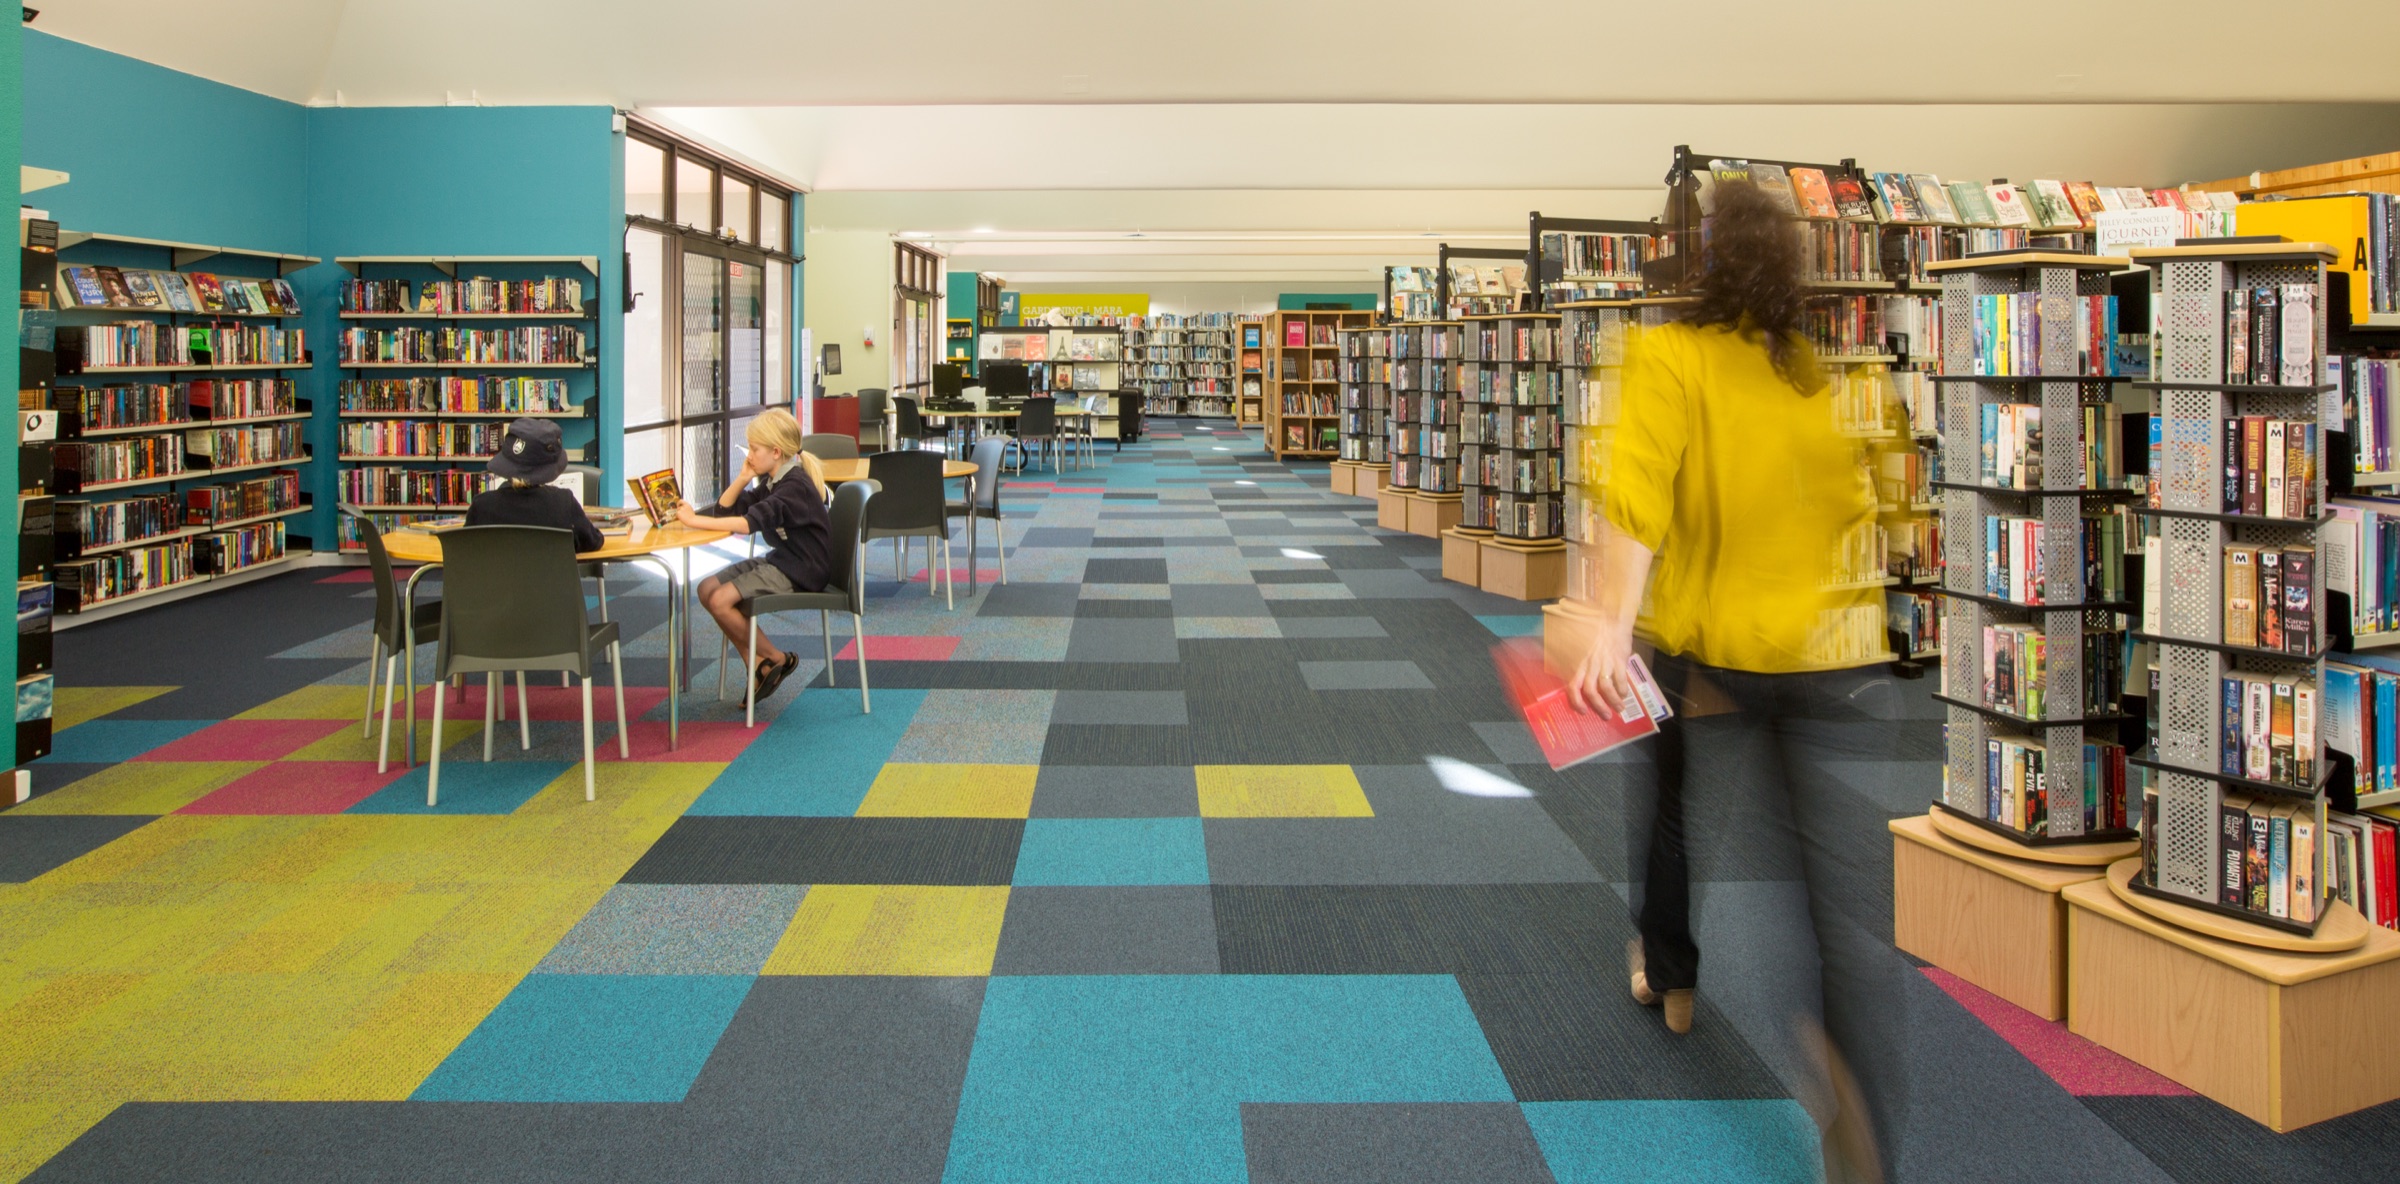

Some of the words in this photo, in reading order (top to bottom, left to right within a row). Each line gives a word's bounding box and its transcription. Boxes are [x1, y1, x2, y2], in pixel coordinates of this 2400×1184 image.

[1837, 201, 1869, 210] WILBUR
[2100, 218, 2121, 227] BILLY
[2122, 215, 2170, 225] CONNOLLY
[2102, 225, 2170, 241] JOURNEY
[2353, 237, 2368, 271] A
[80, 289, 103, 297] FURY
[1022, 306, 1084, 315] GARDNING
[1093, 306, 1123, 315] MARA
[2264, 307, 2272, 346] elizabeth
[2263, 349, 2271, 371] moon
[2248, 421, 2259, 440] BARRY
[2270, 429, 2282, 437] M
[2248, 441, 2259, 470] MAITLAND
[2296, 449, 2304, 476] LINDSAY
[2235, 554, 2247, 563] M
[2285, 617, 2310, 625] Karen
[2285, 622, 2310, 632] Miller
[2253, 710, 2261, 735] MANKELL
[2026, 773, 2035, 792] EVIL
[2224, 815, 2232, 835] HANDS
[2231, 816, 2240, 841] KILLING
[2254, 821, 2266, 831] M
[2227, 860, 2241, 890] MARTIN
